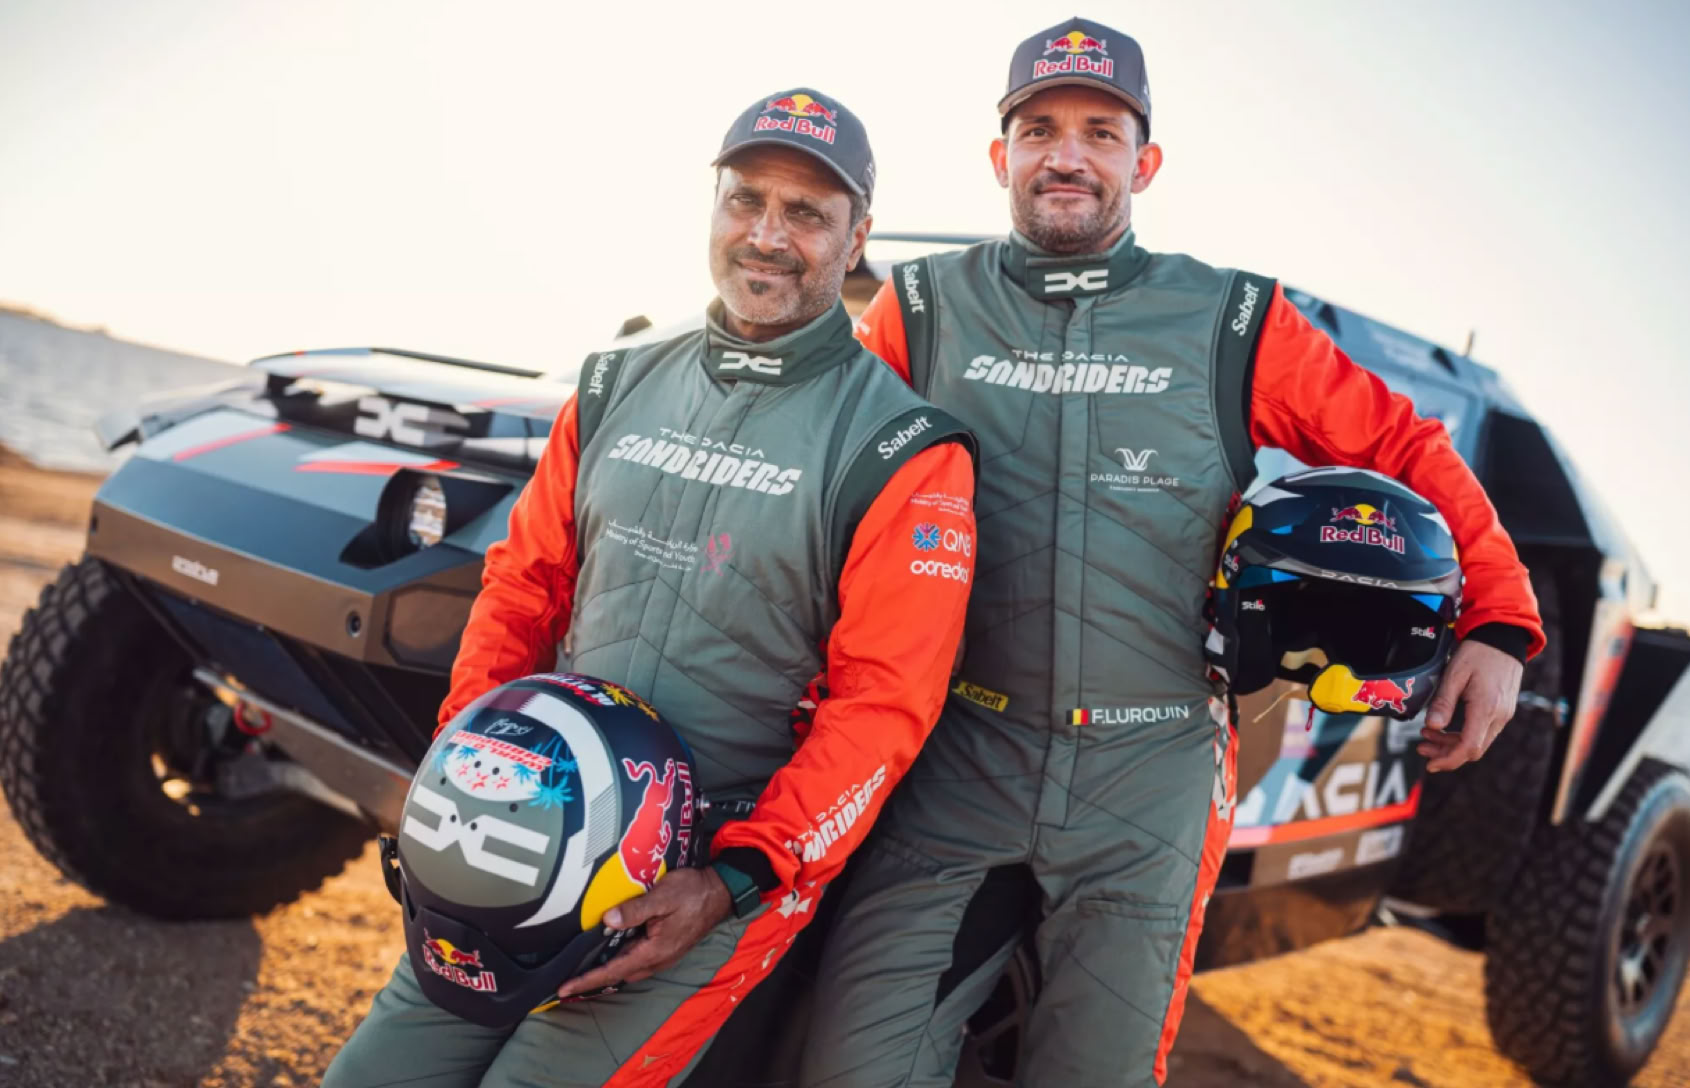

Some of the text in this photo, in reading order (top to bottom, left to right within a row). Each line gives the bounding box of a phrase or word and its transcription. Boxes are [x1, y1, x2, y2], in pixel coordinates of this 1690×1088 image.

[1033, 55, 1113, 80] Red Bull
[754, 116, 836, 144] Red Bull
[903, 264, 925, 313] Sabelt
[1231, 281, 1259, 336] Sabelt
[1012, 349, 1130, 363] THE DACIA
[963, 354, 1173, 395] SANDRIDERS
[660, 427, 765, 459] THE DACIA
[877, 416, 932, 459] Sabelt
[608, 433, 802, 496] SANDRIDERS
[1090, 473, 1179, 487] PARADIS PLAGE
[1320, 525, 1405, 554] Red Bull
[1321, 571, 1398, 589] DACIA
[1092, 705, 1189, 724] F.LURQUIN
[676, 761, 693, 827] Bull
[422, 943, 497, 992] Red Bull
